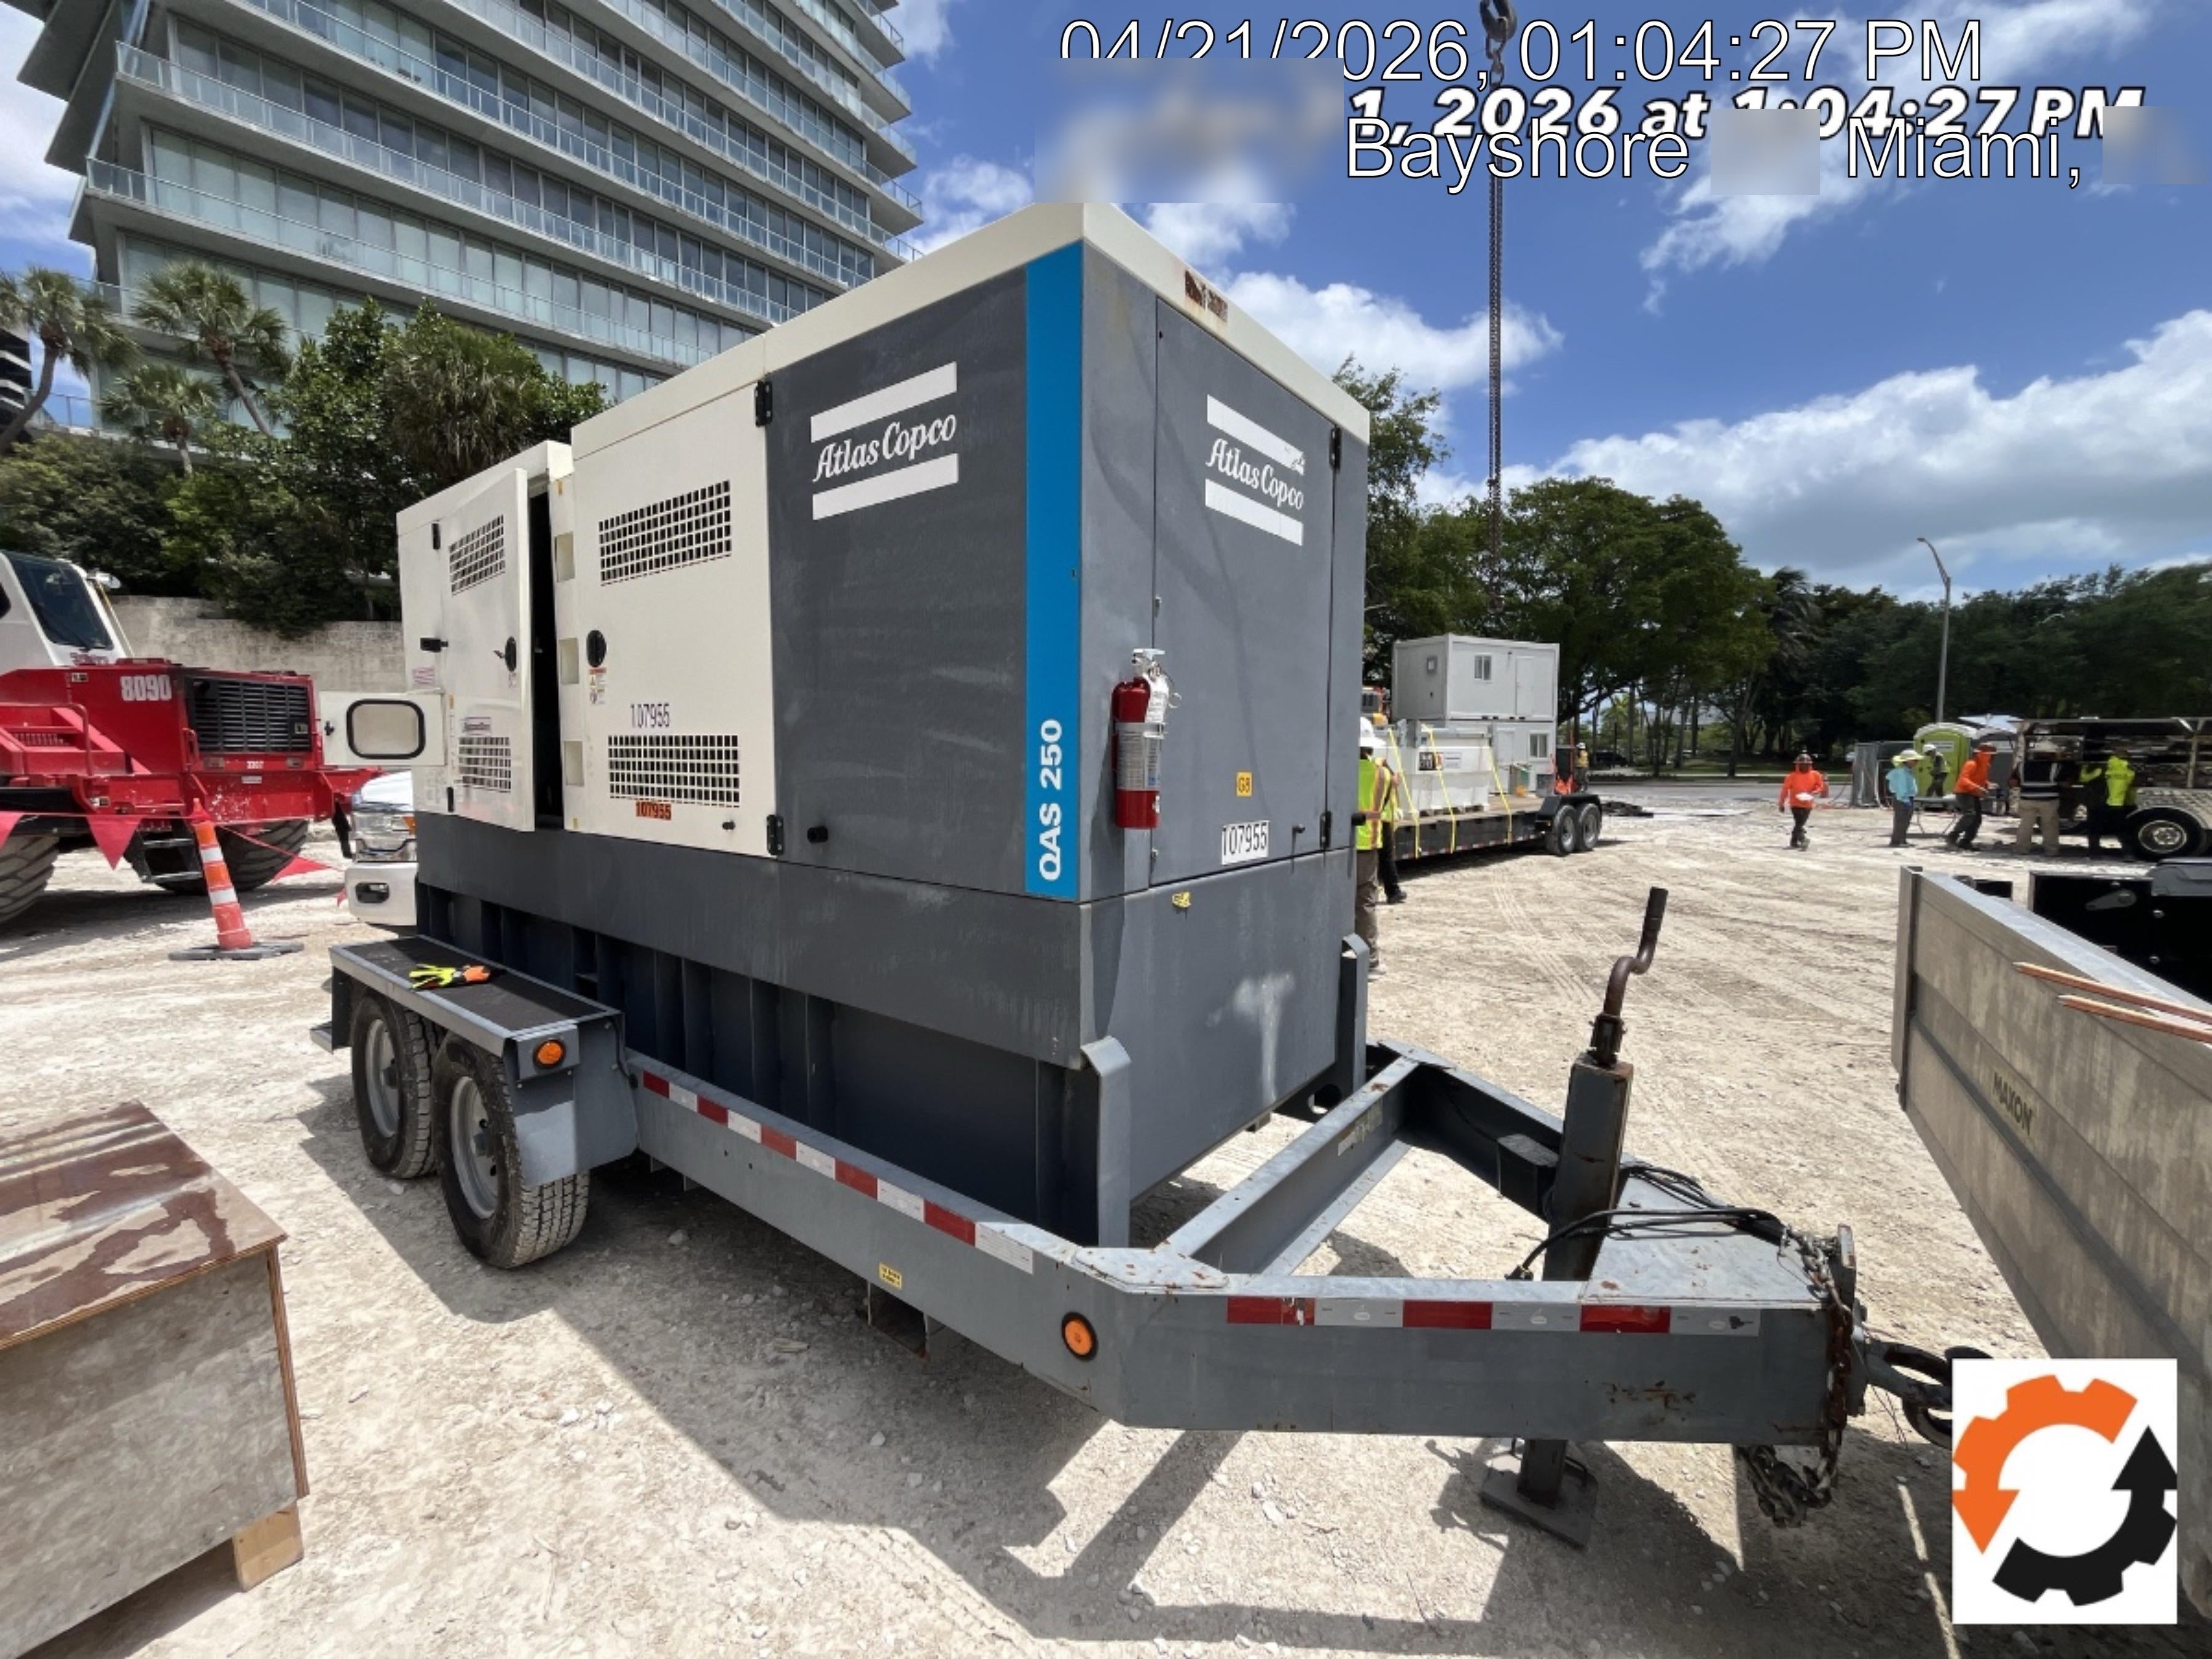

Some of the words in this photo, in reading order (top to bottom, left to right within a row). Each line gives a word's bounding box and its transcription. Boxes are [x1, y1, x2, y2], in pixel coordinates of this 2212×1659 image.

[812, 438, 880, 483] Atlas
[882, 414, 957, 461] Copco
[1205, 438, 1260, 489] Atlas
[1261, 464, 1304, 511] Copco
[120, 674, 172, 702] 8090
[630, 703, 670, 728] 107955
[1040, 719, 1062, 790] 250
[635, 801, 672, 820] 107955
[1039, 802, 1062, 882] QAS
[1223, 822, 1267, 856] 107955
